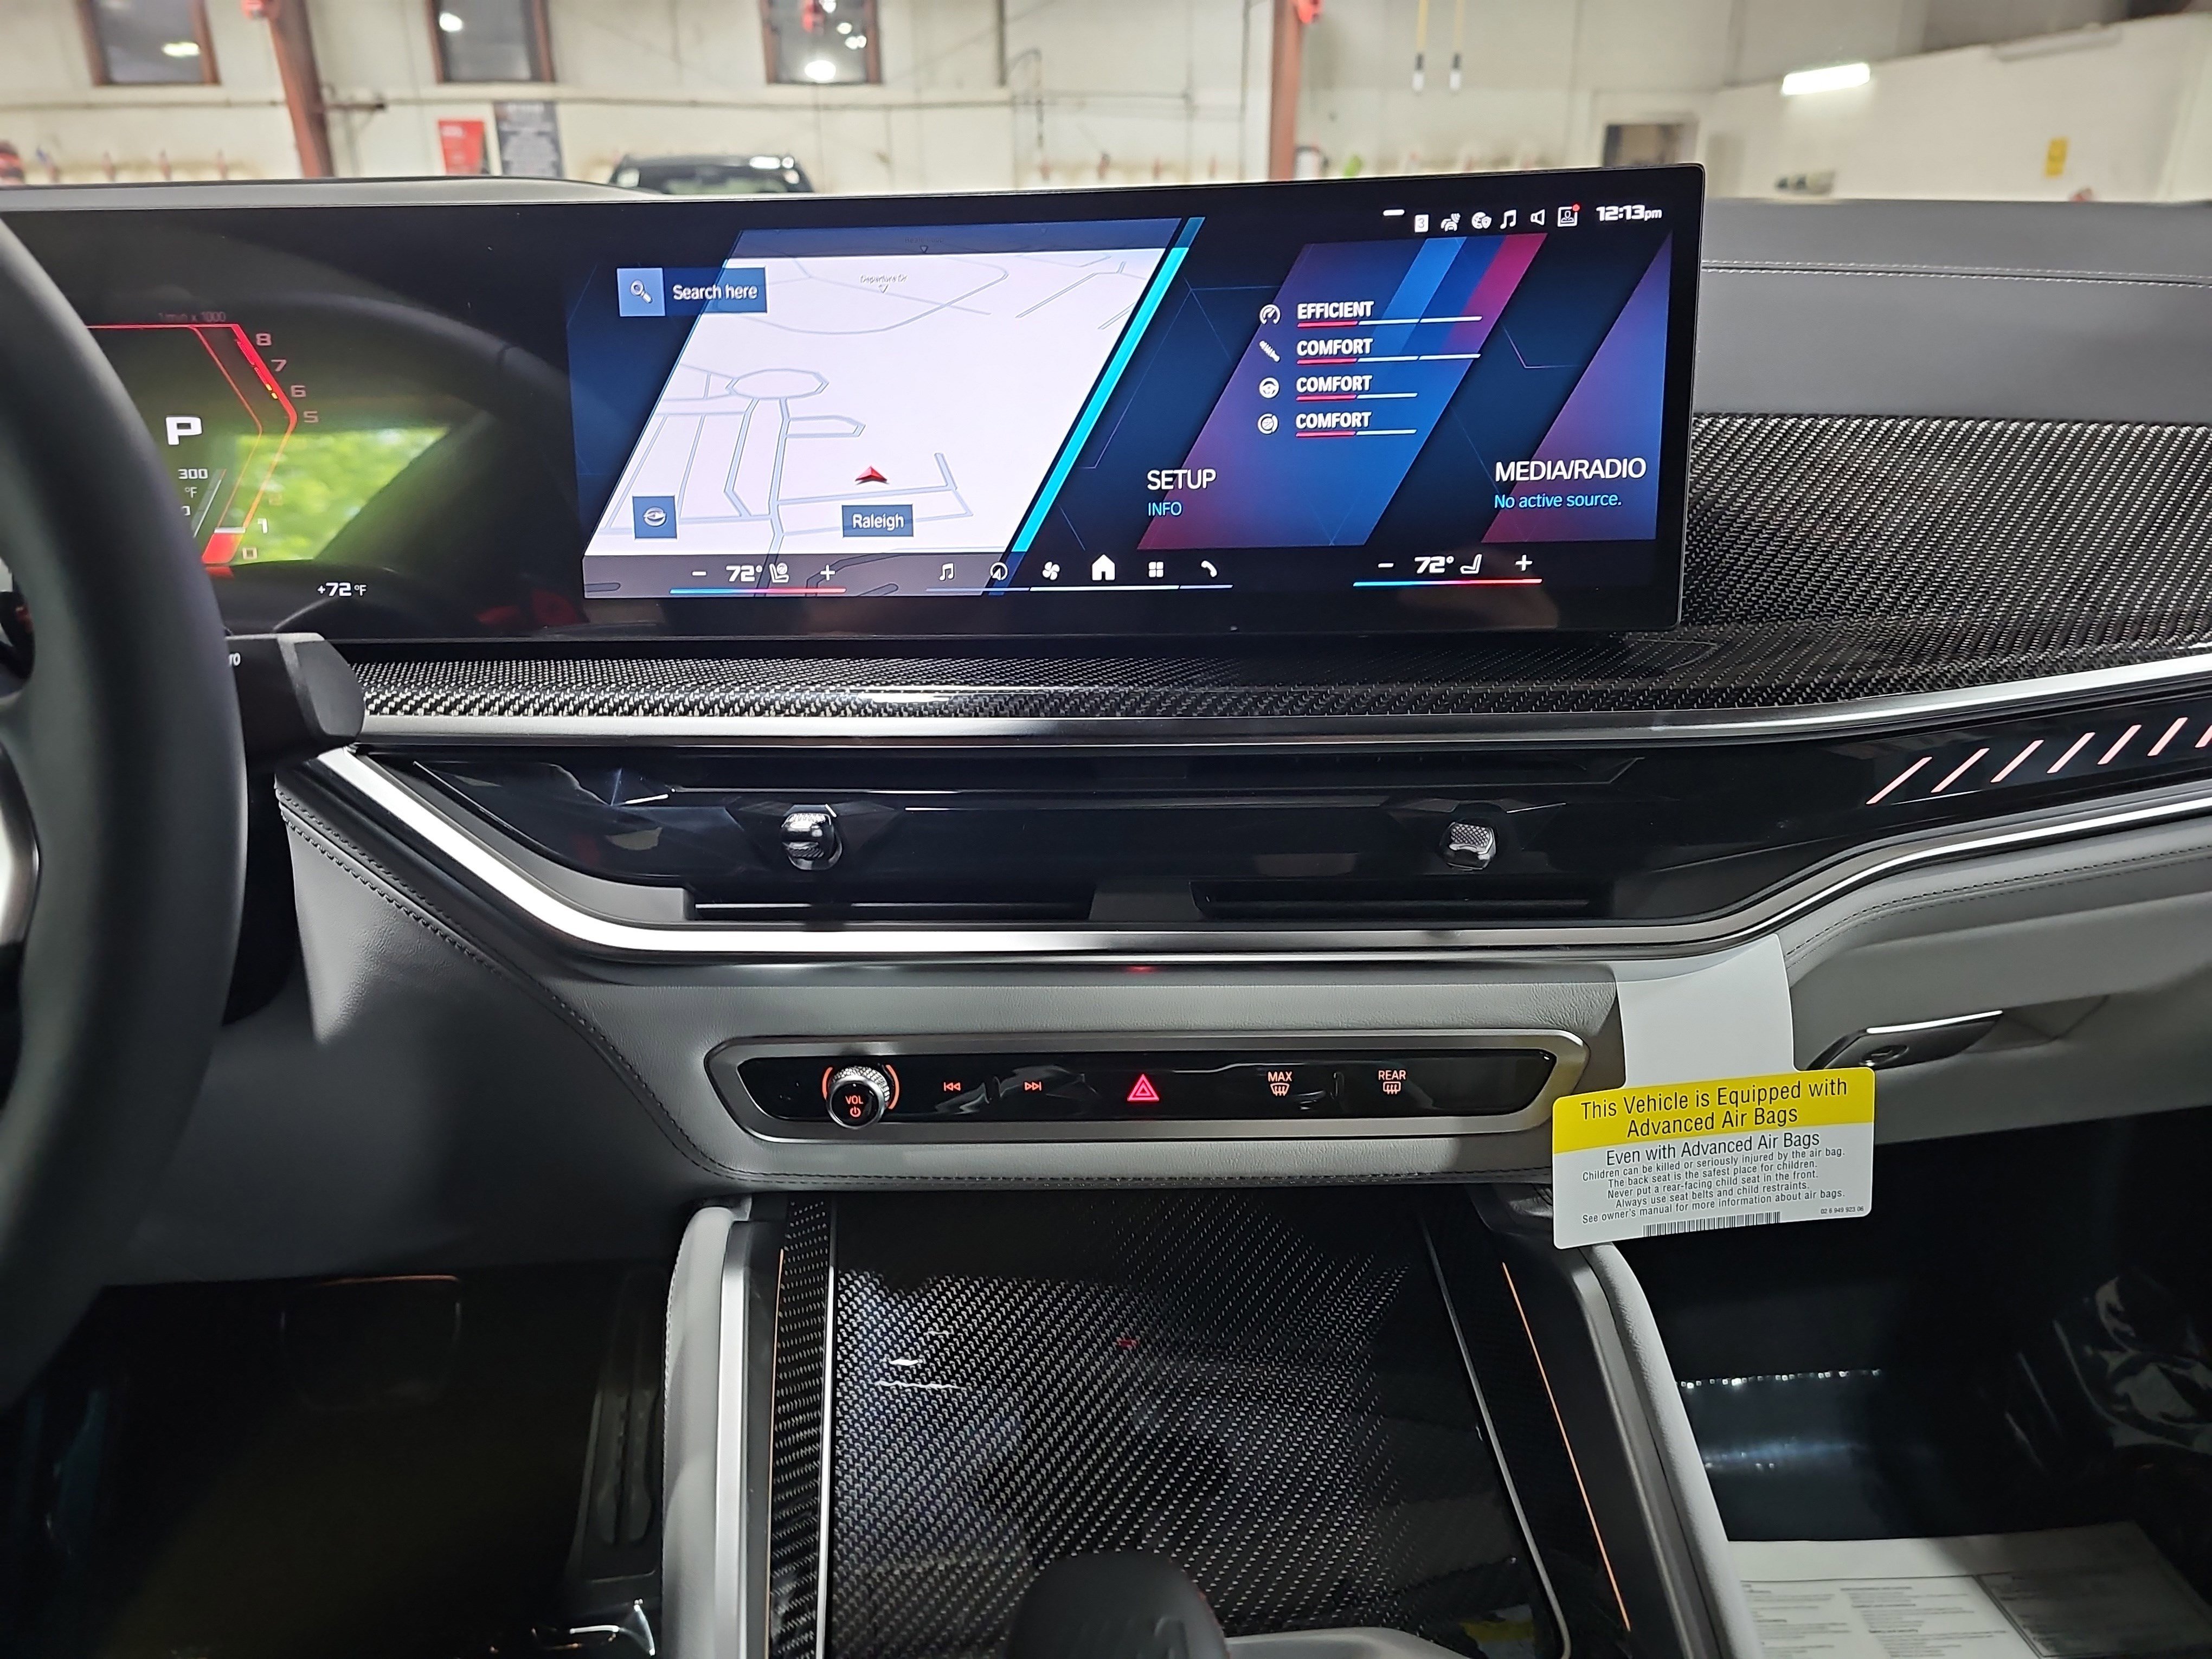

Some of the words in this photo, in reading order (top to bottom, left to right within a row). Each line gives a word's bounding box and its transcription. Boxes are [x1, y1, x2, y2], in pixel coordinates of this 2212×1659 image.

[1596, 204, 1662, 221] 12:13pm
[673, 284, 722, 300] Search
[725, 283, 757, 299] here
[1297, 301, 1374, 319] EFFICIENT
[256, 333, 271, 346] 8
[1296, 338, 1373, 356] COMFORT
[271, 359, 287, 372] 7
[291, 385, 306, 397] 6
[1296, 375, 1372, 393] COMFORT
[303, 410, 319, 423] 5
[1295, 412, 1372, 429] COMFORT
[165, 416, 203, 445] P
[178, 468, 208, 479] 300
[1495, 458, 1647, 482] MEDIA/RADIO
[1147, 469, 1216, 490] SETUP
[1148, 501, 1182, 516] INFO
[1494, 494, 1515, 509] No
[1519, 493, 1562, 507] active
[1566, 494, 1622, 506] source.
[853, 513, 904, 531] Raleigh
[228, 652, 241, 666] TO
[1268, 1071, 1293, 1082] MAX
[1378, 1070, 1406, 1081] REAR
[845, 1095, 864, 1104] VOL
[1581, 1099, 1617, 1120] This
[1623, 1091, 1688, 1114] Vehicle
[1696, 1090, 1710, 1108] is
[1718, 1081, 1801, 1108] Equipped
[1808, 1078, 1847, 1097] with
[1627, 1112, 1714, 1137] Advanced
[1721, 1110, 1747, 1128] Air
[1754, 1108, 1797, 1127] Bags
[1607, 1150, 1640, 1166] Even
[1645, 1144, 1676, 1161] with
[1681, 1135, 1752, 1158] Advanced
[1758, 1134, 1779, 1150] Air
[1784, 1132, 1819, 1149] Bags
[1583, 1169, 1619, 1181] Children
[1623, 1167, 1638, 1176] can
[1642, 1165, 1652, 1173] be
[1656, 1161, 1680, 1172] killed
[1696, 1155, 1738, 1168] seriously
[1742, 1152, 1773, 1164] injured
[1778, 1152, 1788, 1161] by
[1792, 1149, 1806, 1159] the
[1809, 1148, 1822, 1157] air
[1825, 1148, 1845, 1158] bag.
[1608, 1178, 1624, 1188] The
[1628, 1175, 1649, 1186] back
[1652, 1173, 1670, 1182] seat
[1674, 1172, 1682, 1181] is
[1685, 1170, 1699, 1179] the
[1702, 1167, 1730, 1178] safest
[1733, 1166, 1757, 1176] place
[1761, 1163, 1773, 1172] for
[1777, 1160, 1817, 1171] children.
[1608, 1189, 1633, 1199] Never
[1637, 1185, 1651, 1197] put
[1663, 1180, 1712, 1192] rear-facing
[1716, 1176, 1738, 1187] child
[1741, 1175, 1760, 1184] seat
[1764, 1173, 1772, 1182] in
[1776, 1173, 1790, 1181] the
[1793, 1170, 1818, 1180] front.
[1616, 1198, 1647, 1208] Always
[1651, 1195, 1666, 1204] use
[1669, 1192, 1688, 1202] seat
[1692, 1190, 1714, 1199] belts
[1717, 1187, 1733, 1197] and
[1737, 1184, 1759, 1195] child
[1763, 1181, 1810, 1192] restraints.
[1583, 1214, 1598, 1224] See
[1639, 1204, 1672, 1216] manual
[1676, 1203, 1688, 1212] for
[1692, 1201, 1715, 1210] more
[1719, 1195, 1772, 1207] information
[1775, 1192, 1801, 1202] about
[1804, 1190, 1817, 1199] air
[1820, 1189, 1845, 1199] bags.
